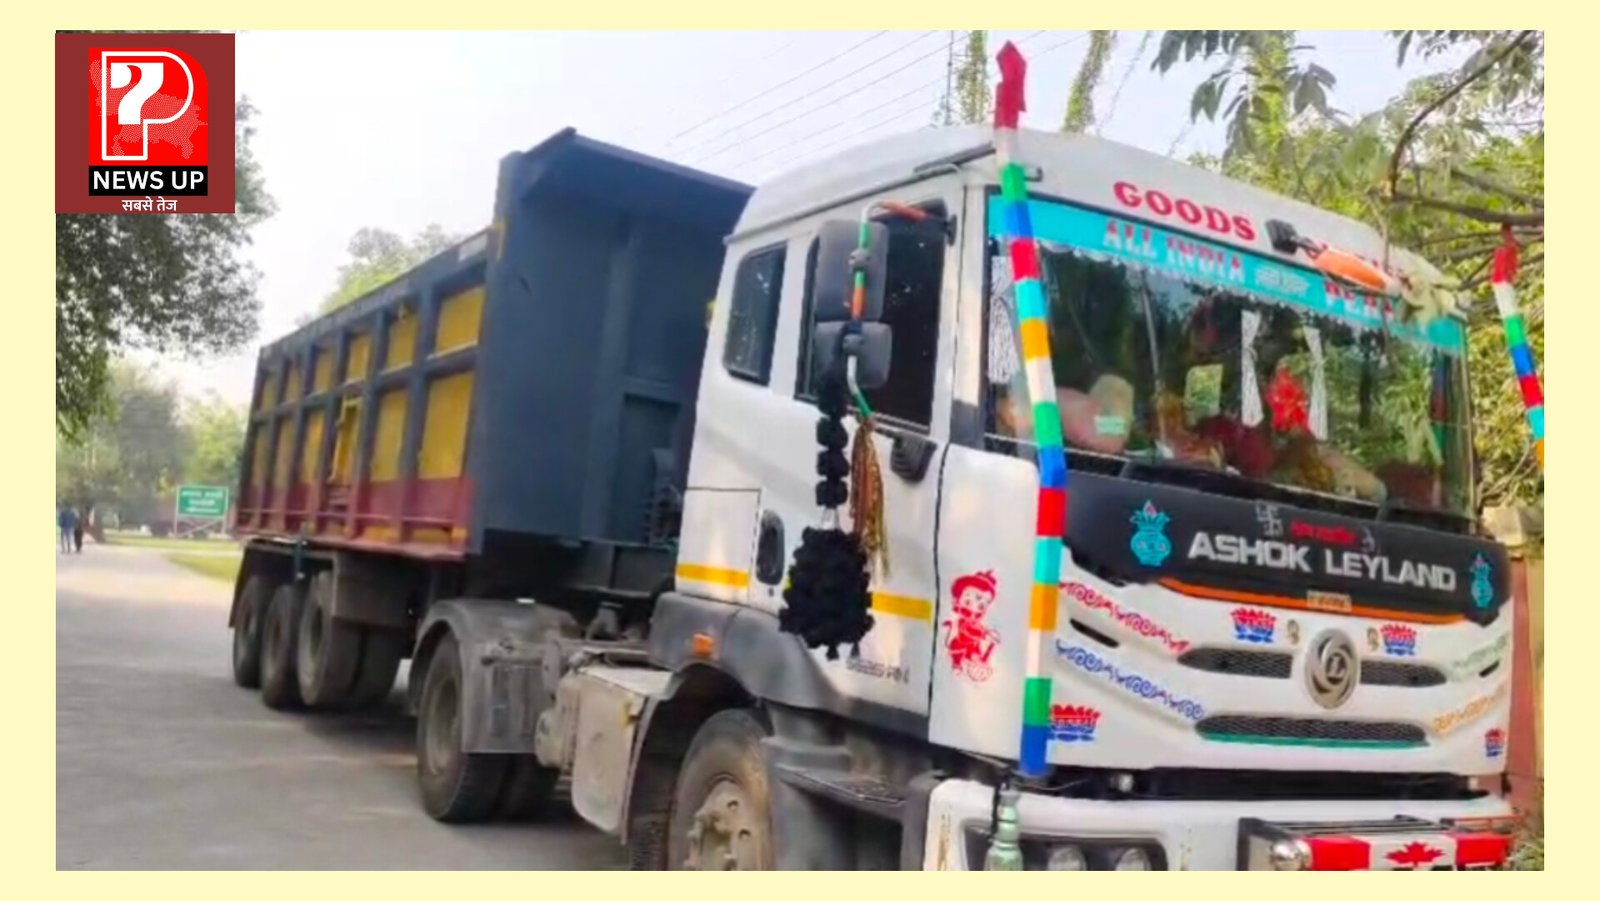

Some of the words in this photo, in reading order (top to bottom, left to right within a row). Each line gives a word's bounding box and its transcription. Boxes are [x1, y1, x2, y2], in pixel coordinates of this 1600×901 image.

[1113, 181, 1256, 241] GOODS
[1103, 219, 1158, 259] ALL
[1167, 236, 1245, 283] INDIA
[1188, 532, 1311, 572] ASHOK
[1325, 549, 1456, 590] LEYLAND
